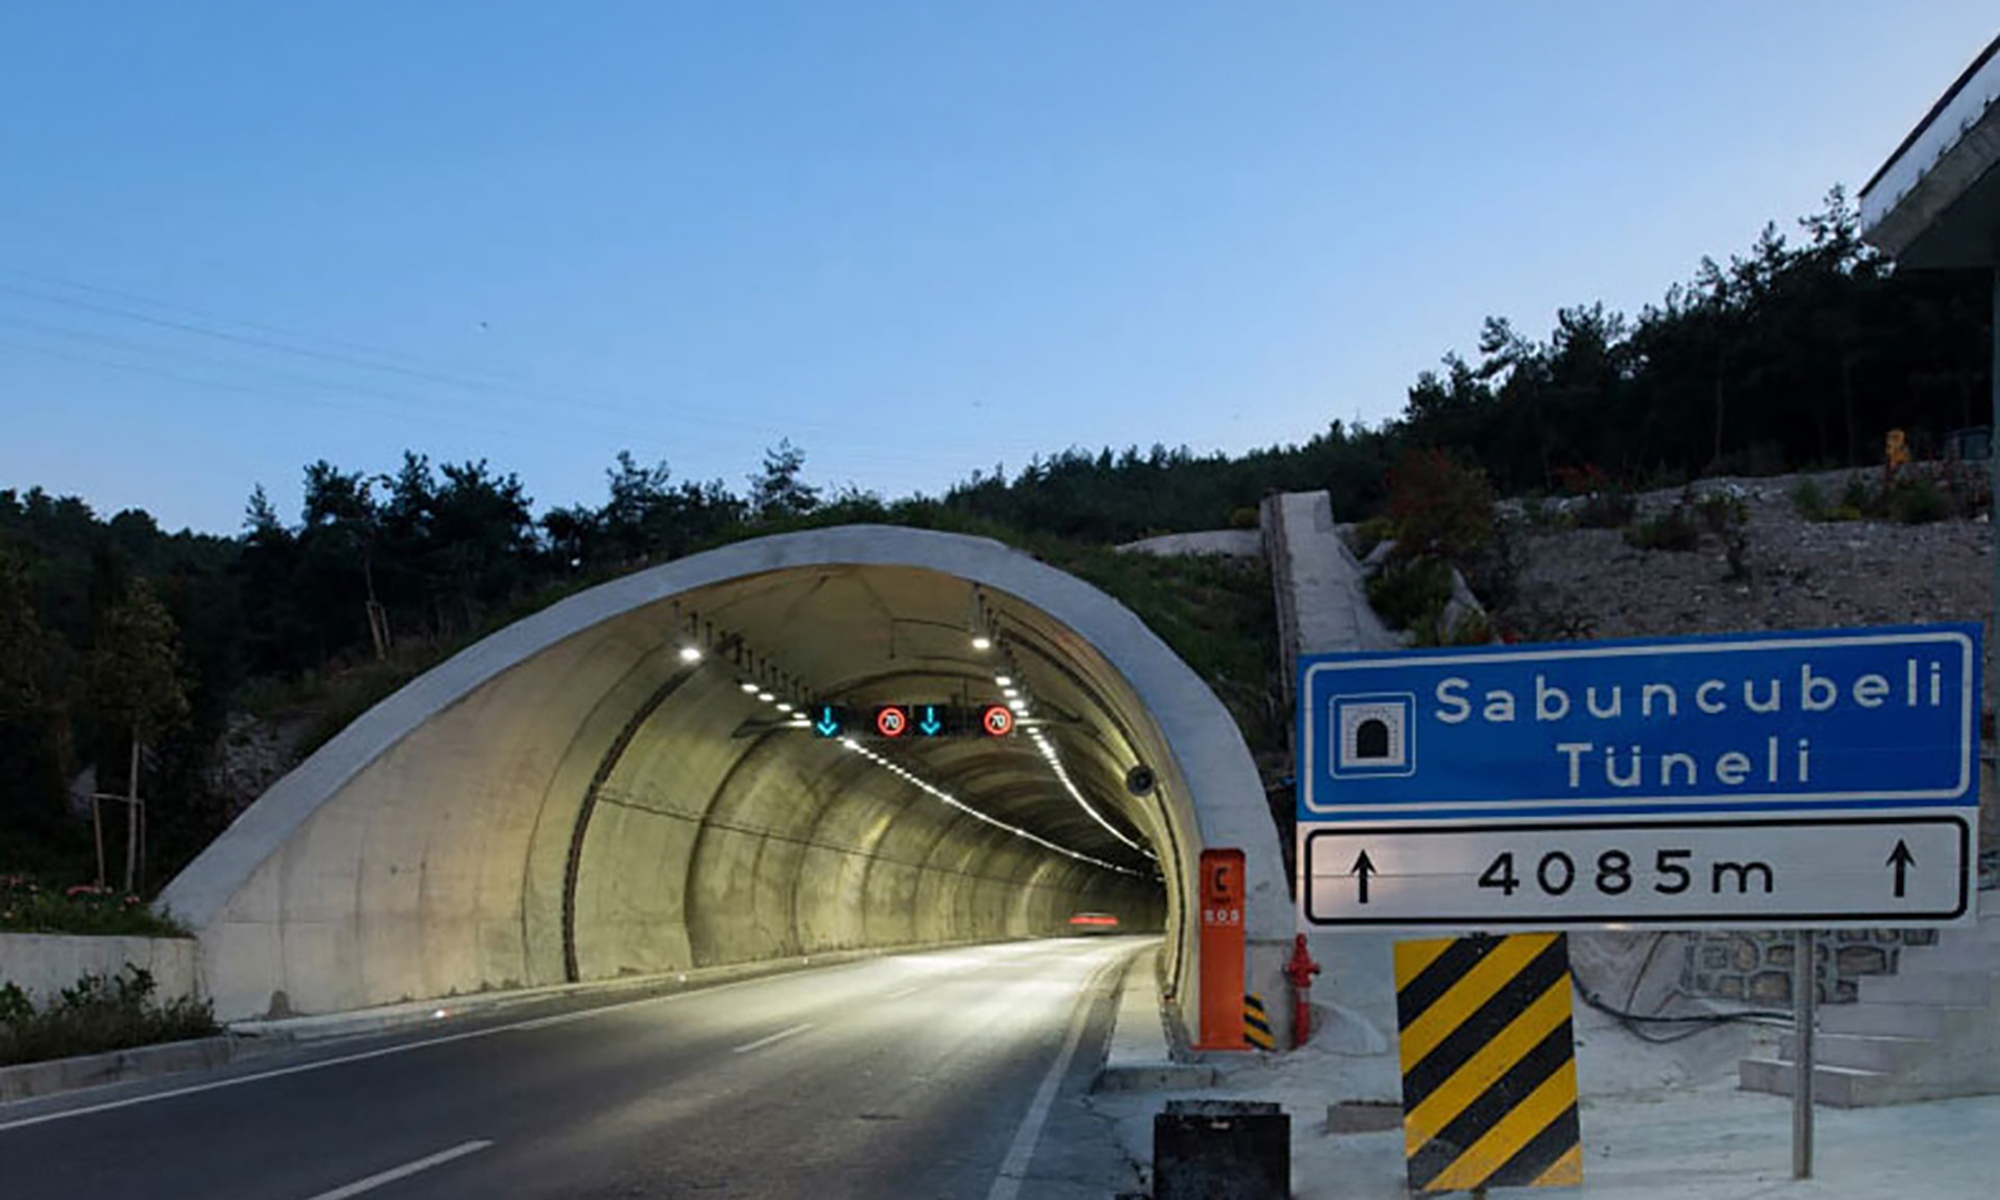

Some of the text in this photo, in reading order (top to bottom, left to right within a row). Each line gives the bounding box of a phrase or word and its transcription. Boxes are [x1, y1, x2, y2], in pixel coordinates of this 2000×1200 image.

[1434, 658, 1942, 724] Sabuncubeli
[885, 715, 899, 728] 70
[991, 714, 1006, 728] 70
[1557, 737, 1810, 788] Tüneli
